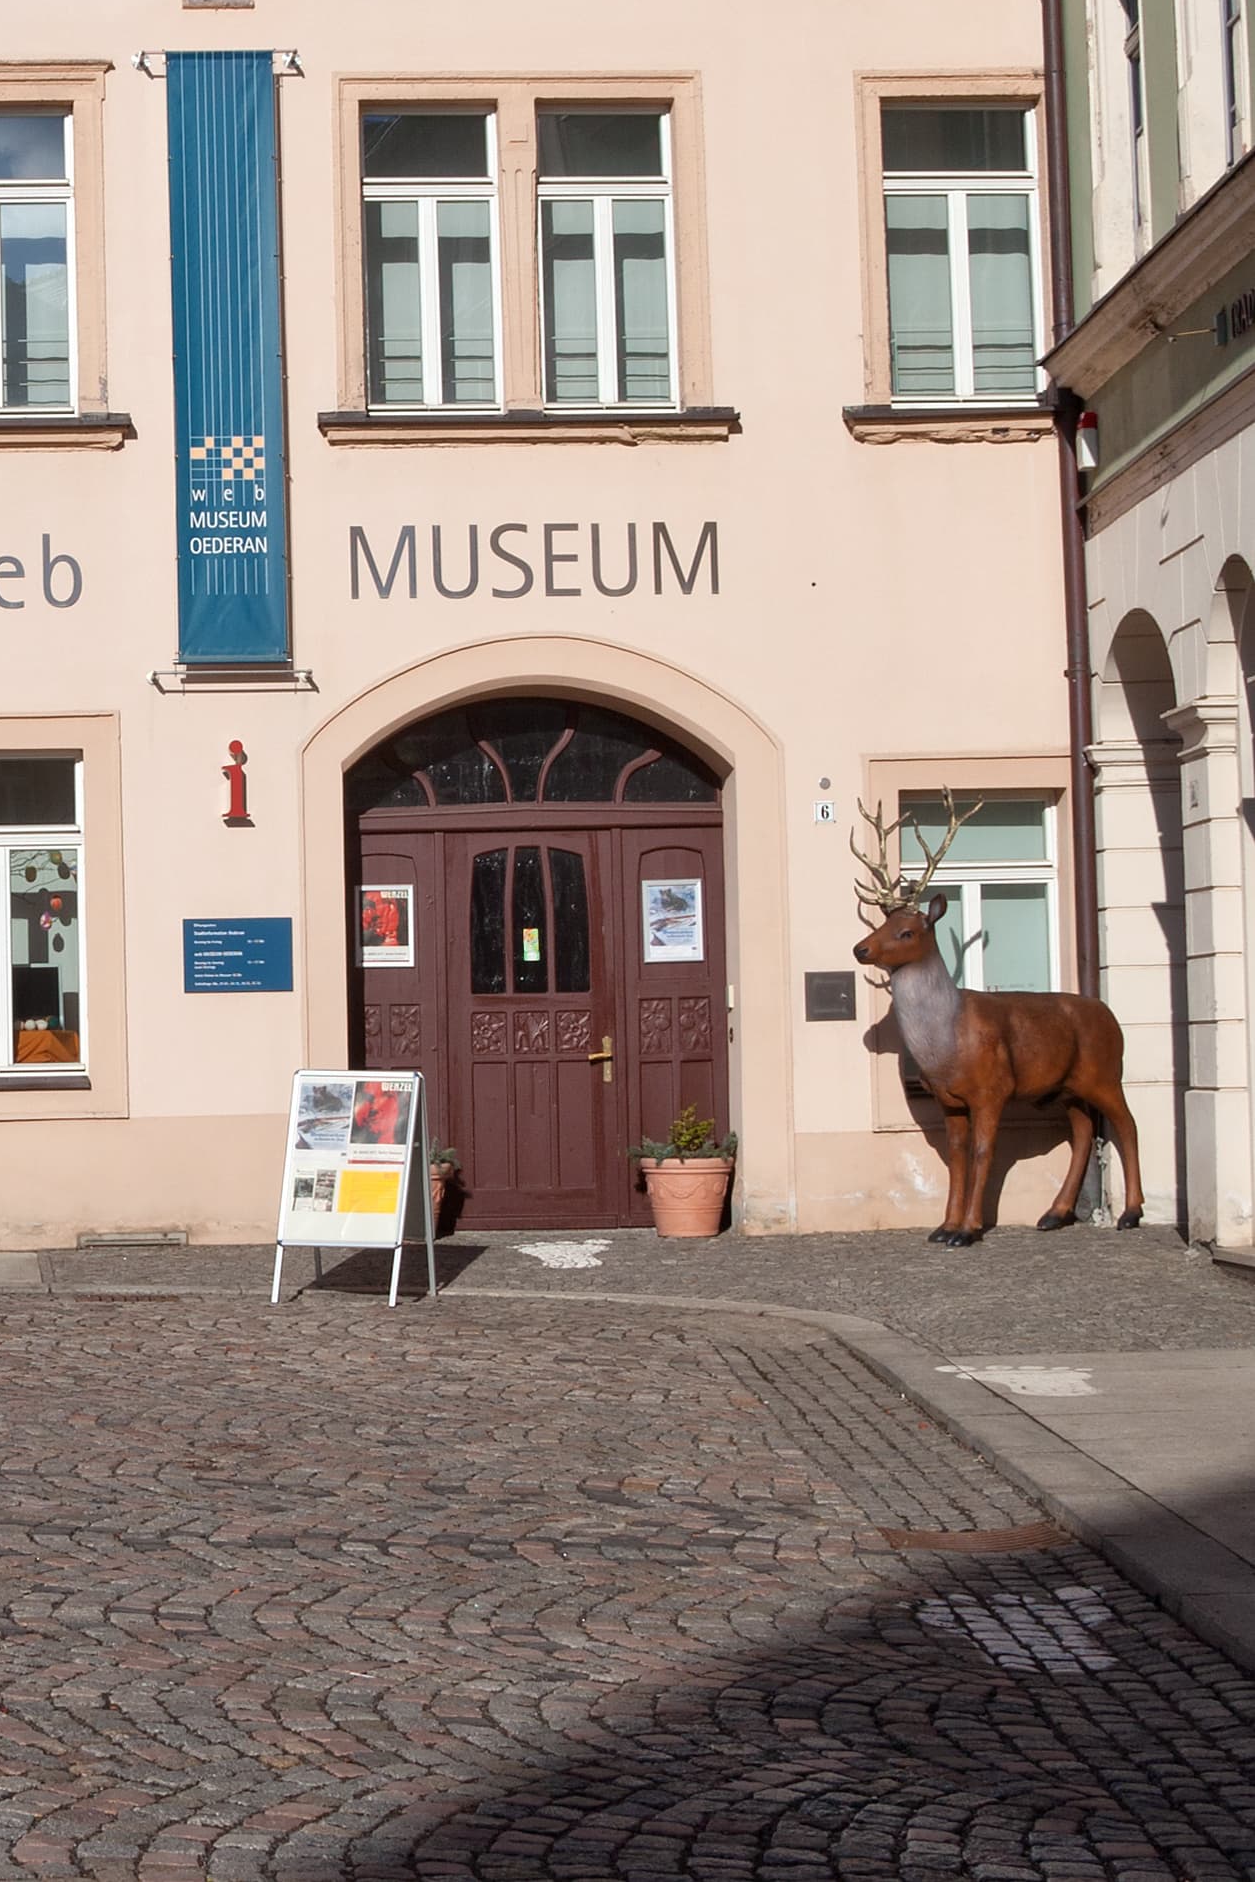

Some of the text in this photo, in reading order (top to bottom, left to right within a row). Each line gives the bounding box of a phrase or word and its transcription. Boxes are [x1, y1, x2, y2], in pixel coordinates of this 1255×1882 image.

[192, 484, 265, 501] web
[189, 511, 267, 528] MUSEUM
[189, 536, 267, 555] OEDERAN
[349, 521, 720, 600] MUSEUM
[221, 739, 251, 818] i
[820, 804, 830, 820] 6
